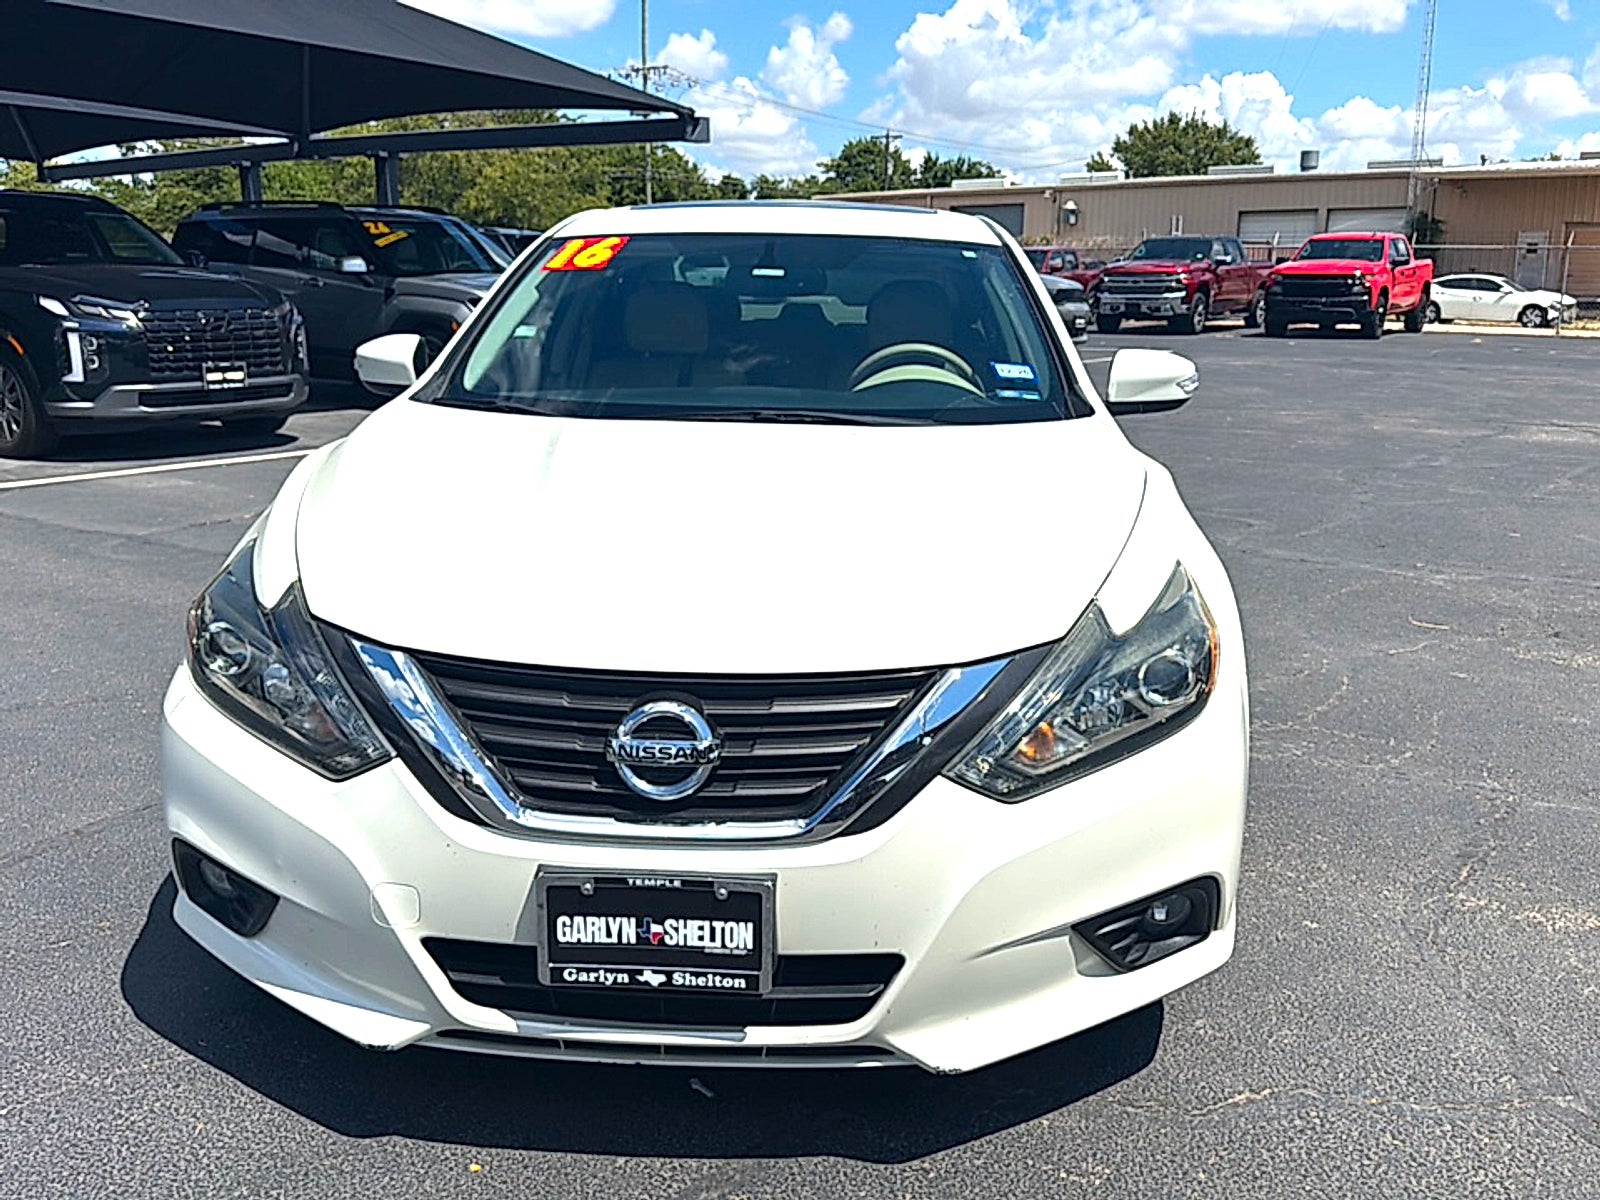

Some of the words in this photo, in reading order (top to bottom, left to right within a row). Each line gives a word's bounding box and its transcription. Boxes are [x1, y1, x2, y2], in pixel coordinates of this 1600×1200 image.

[545, 237, 621, 268] 16
[618, 744, 708, 761] NISSAN
[627, 878, 682, 888] TEMPLE
[556, 916, 637, 944] GARLYN
[663, 919, 754, 950] SHELTON
[563, 968, 630, 984] Garlyn
[672, 971, 747, 988] Shelton
